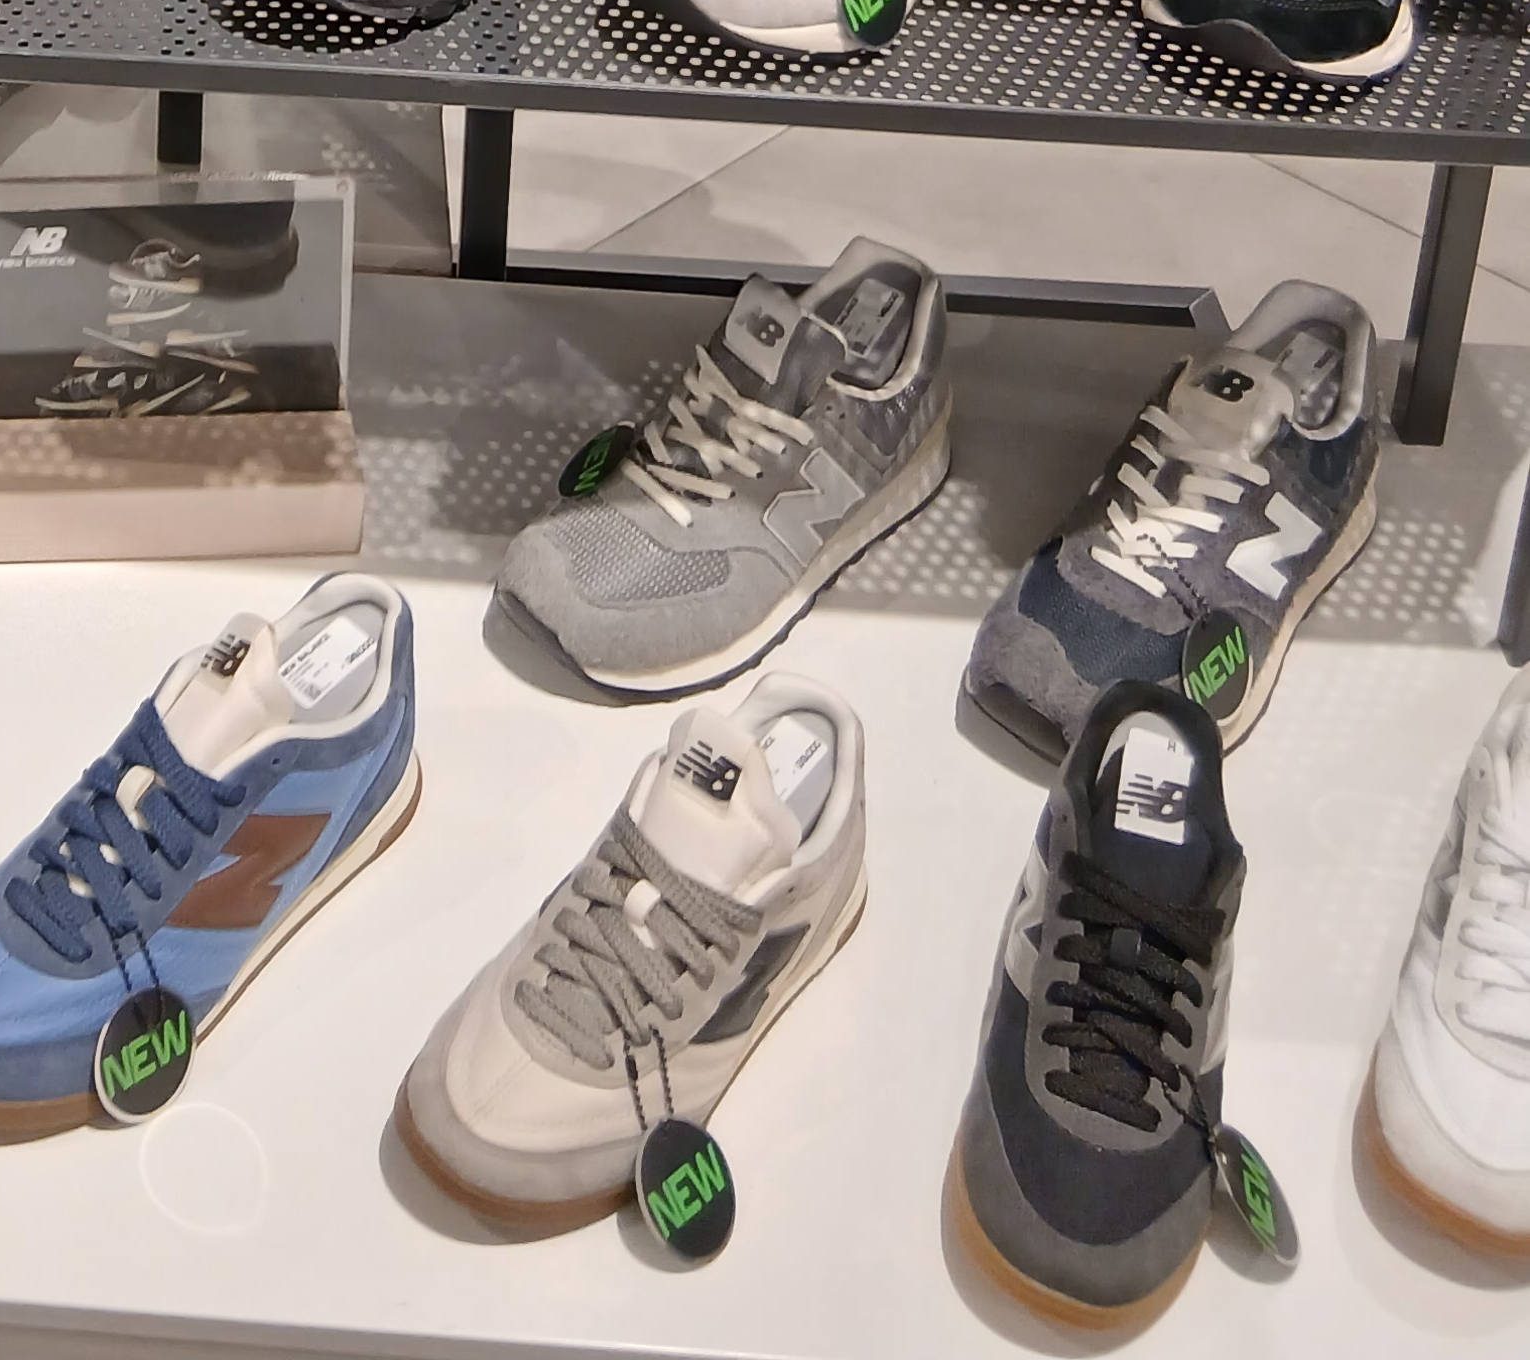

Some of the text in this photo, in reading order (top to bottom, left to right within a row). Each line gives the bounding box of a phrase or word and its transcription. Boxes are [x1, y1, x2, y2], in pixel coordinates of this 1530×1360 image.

[9, 225, 69, 257] NB
[1188, 625, 1246, 707] NEW
[102, 1010, 187, 1101] NEW
[646, 1142, 726, 1240] NEW
